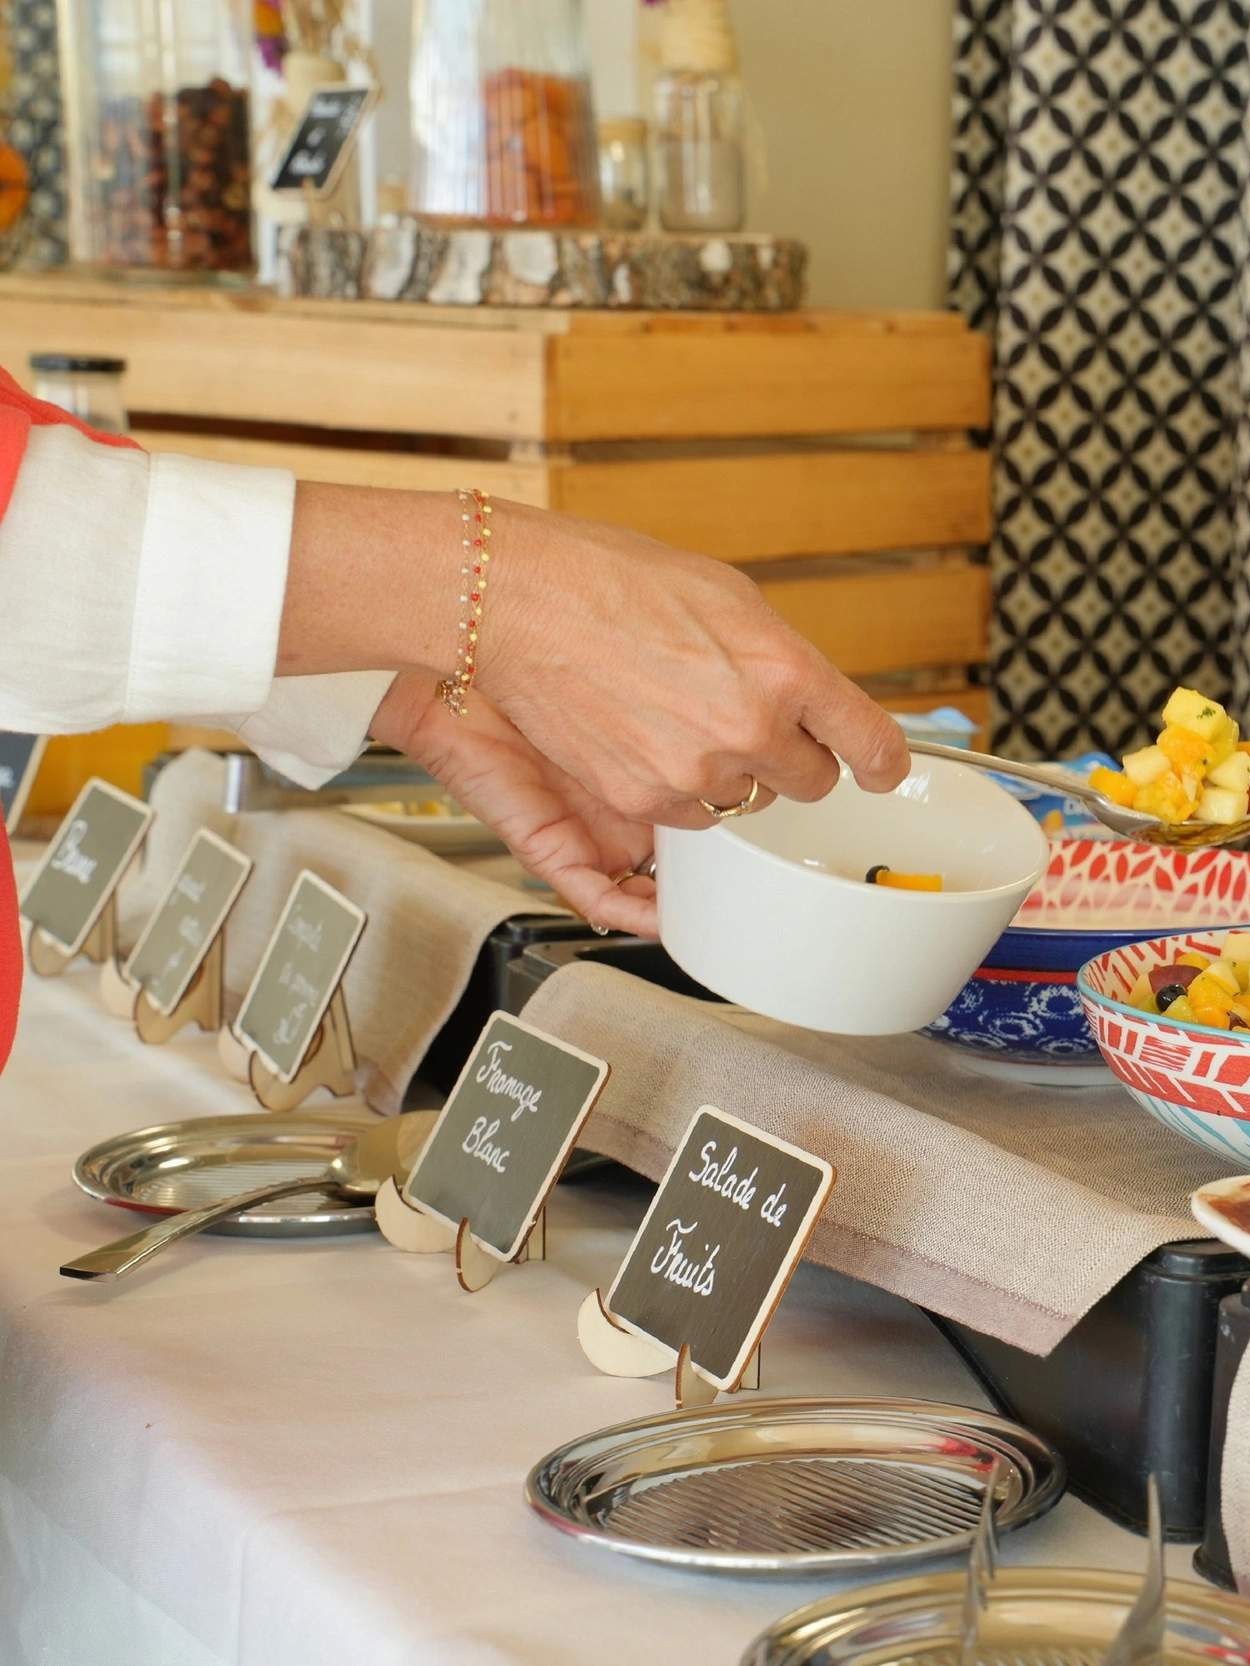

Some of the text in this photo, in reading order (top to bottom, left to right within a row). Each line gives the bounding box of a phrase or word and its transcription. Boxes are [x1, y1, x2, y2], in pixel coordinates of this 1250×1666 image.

[475, 1040, 543, 1122] Fromage
[461, 1116, 511, 1173] Blanc
[688, 1140, 789, 1228] Salade de
[650, 1218, 722, 1297] Fruits
